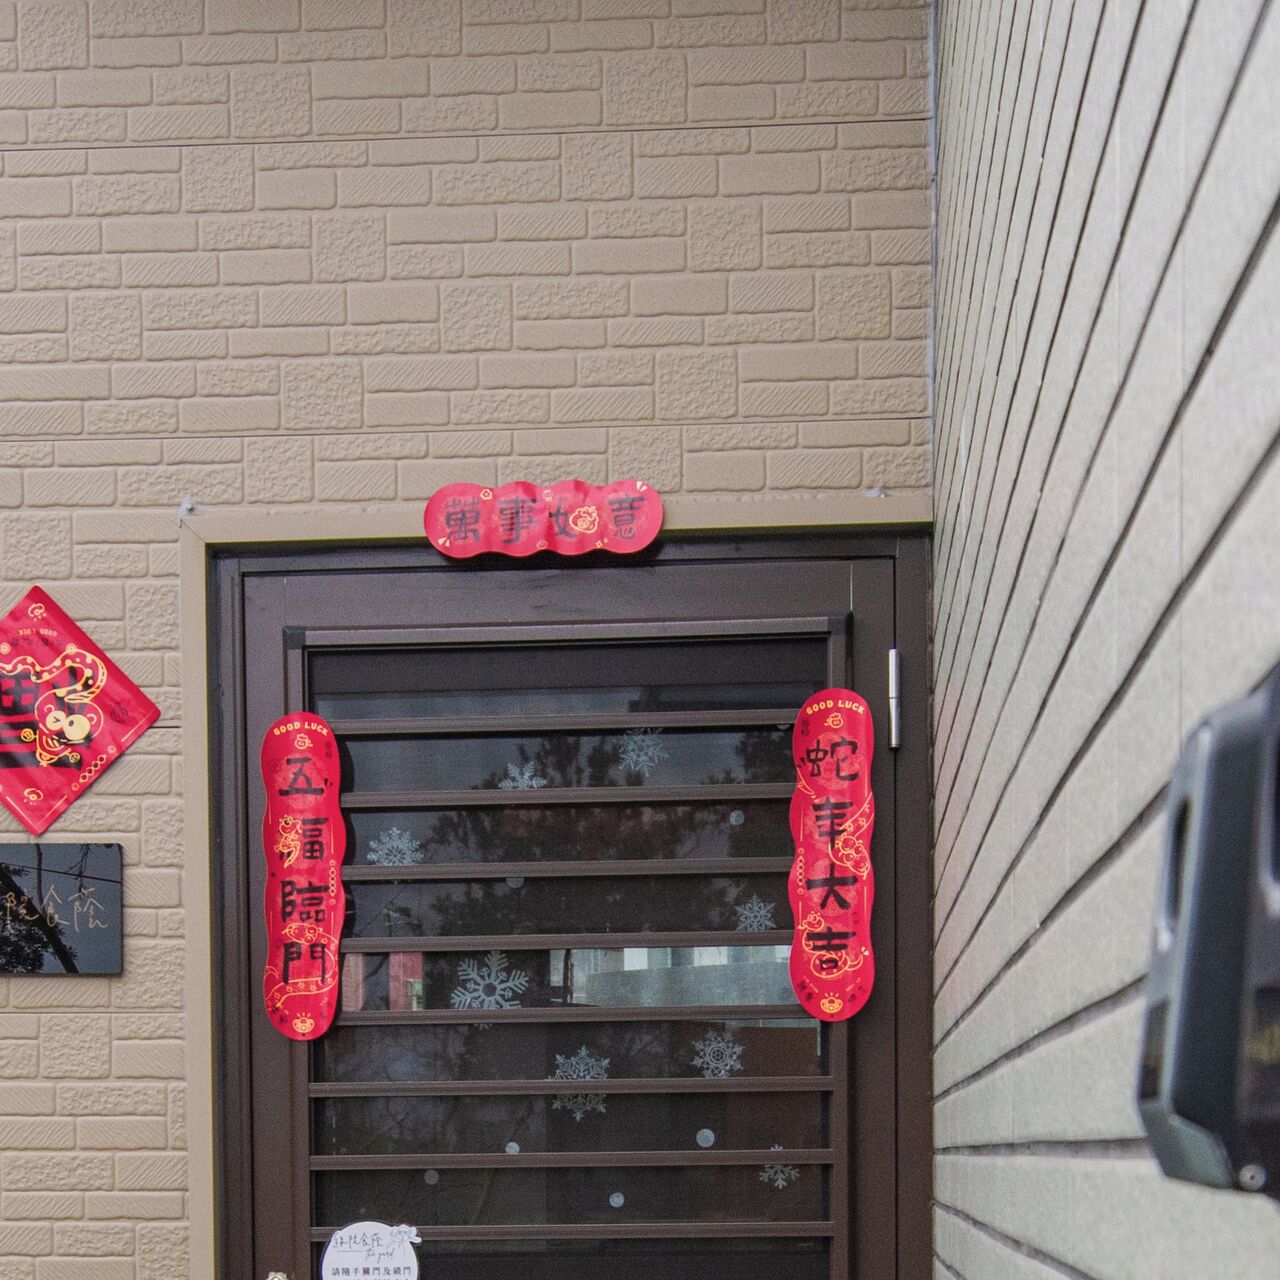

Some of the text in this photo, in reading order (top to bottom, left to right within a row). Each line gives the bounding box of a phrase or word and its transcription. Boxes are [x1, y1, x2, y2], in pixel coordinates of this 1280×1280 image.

[273, 720, 329, 737] GOOD LUCK
[806, 699, 866, 715] GOOD LUCK
[276, 757, 330, 985] 五福臨門
[805, 736, 860, 972] 蛇年大吉
